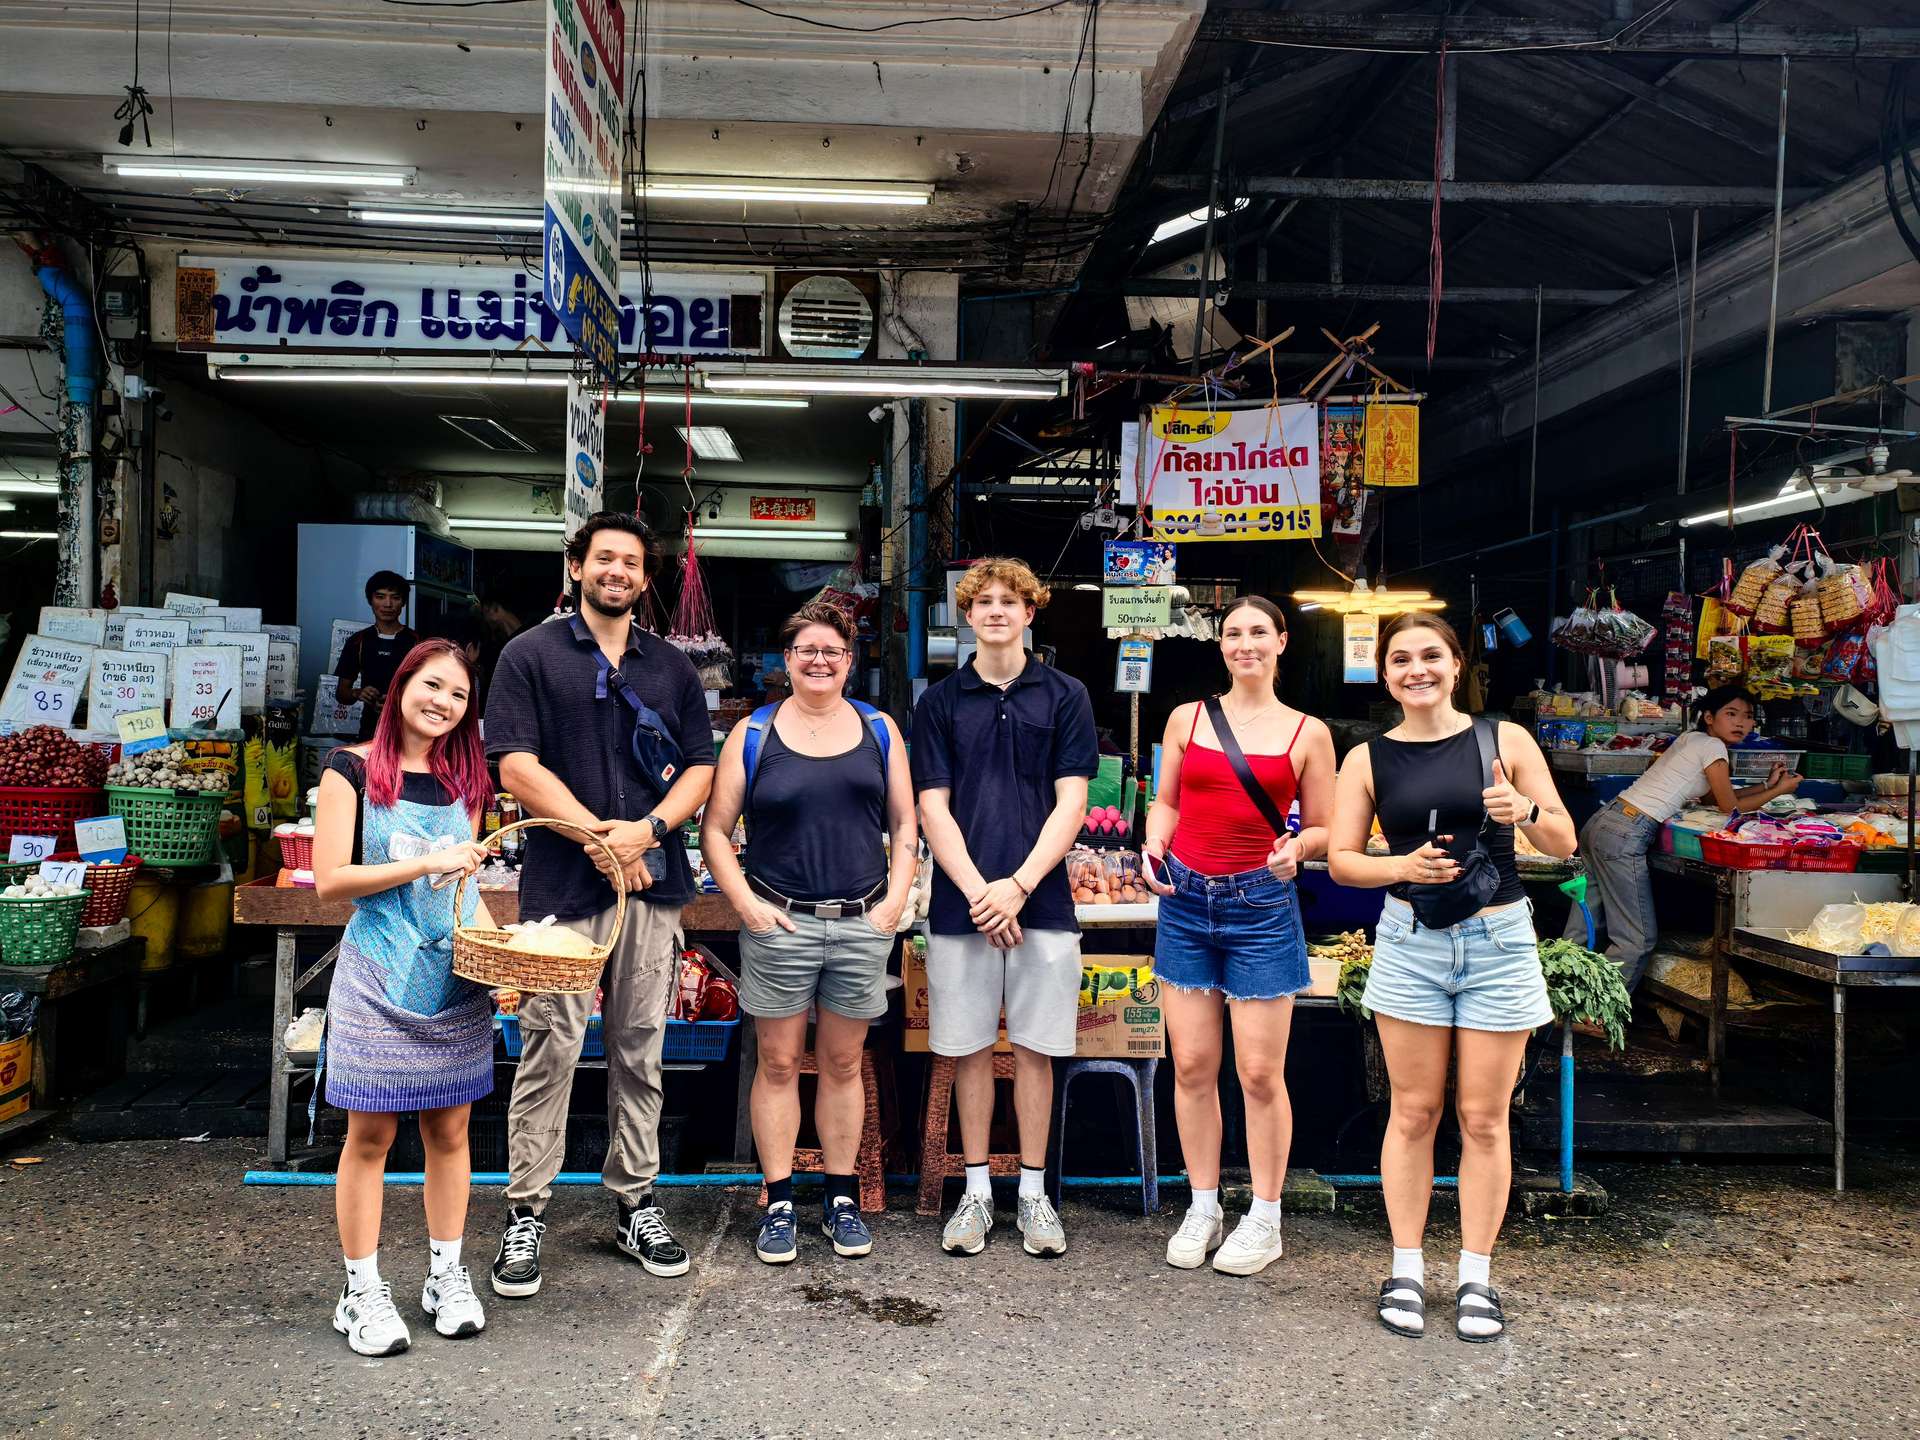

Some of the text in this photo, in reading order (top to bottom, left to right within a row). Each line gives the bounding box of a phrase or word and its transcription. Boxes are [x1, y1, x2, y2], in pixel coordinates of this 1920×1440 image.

[210, 265, 399, 338] น้ำพริก
[1163, 441, 1309, 473] กัลยาไก่สด
[1258, 509, 1311, 532] 5915
[102, 660, 155, 673] ข้าวเหนียว
[117, 687, 136, 699] 30
[196, 683, 213, 695] 33
[34, 690, 63, 711] 85
[191, 705, 216, 719] 495
[23, 842, 43, 858] 90
